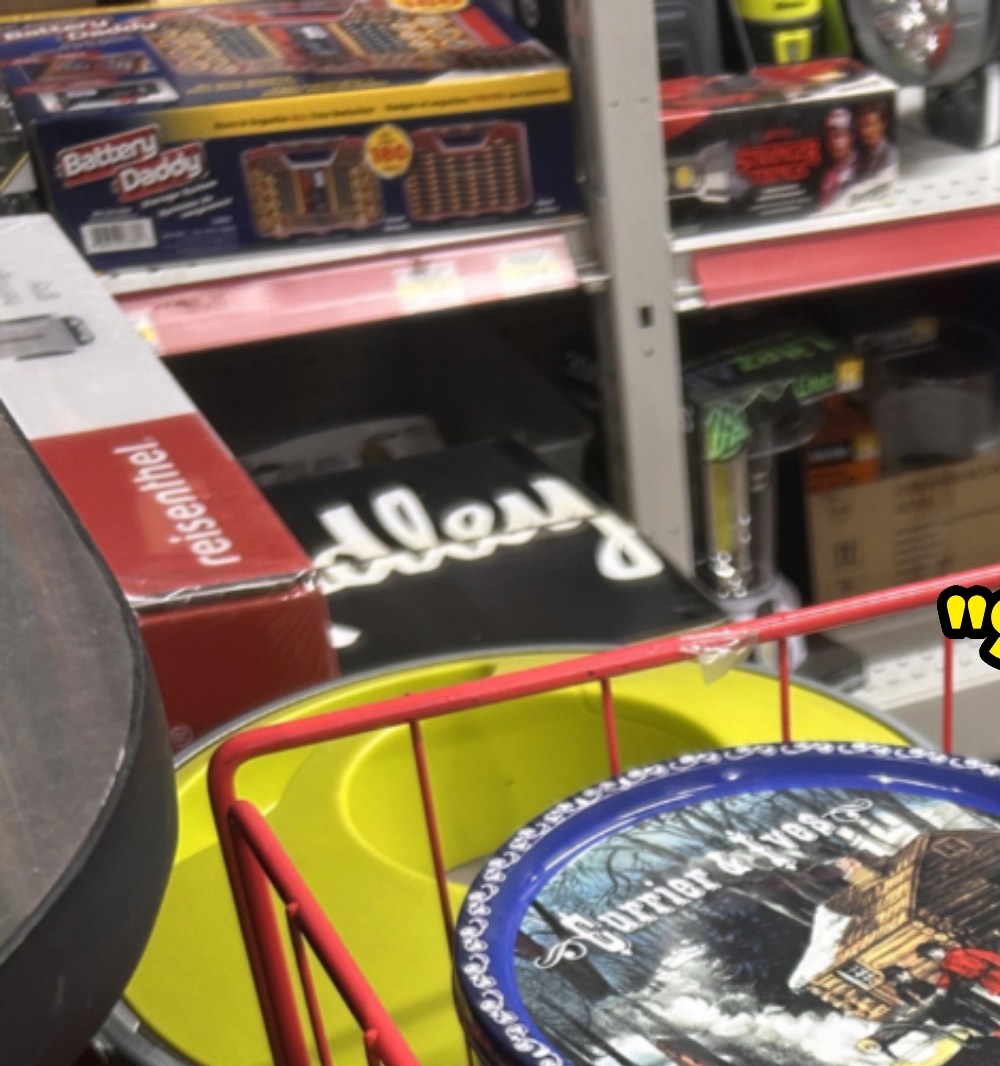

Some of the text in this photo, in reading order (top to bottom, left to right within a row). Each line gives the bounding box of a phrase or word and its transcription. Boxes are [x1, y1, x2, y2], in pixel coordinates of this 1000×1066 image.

[61, 133, 158, 177] Battery
[118, 150, 202, 194] Daddy
[112, 441, 242, 567] reisenthel
[558, 868, 723, 956] Currier
[725, 811, 835, 873] Ives
